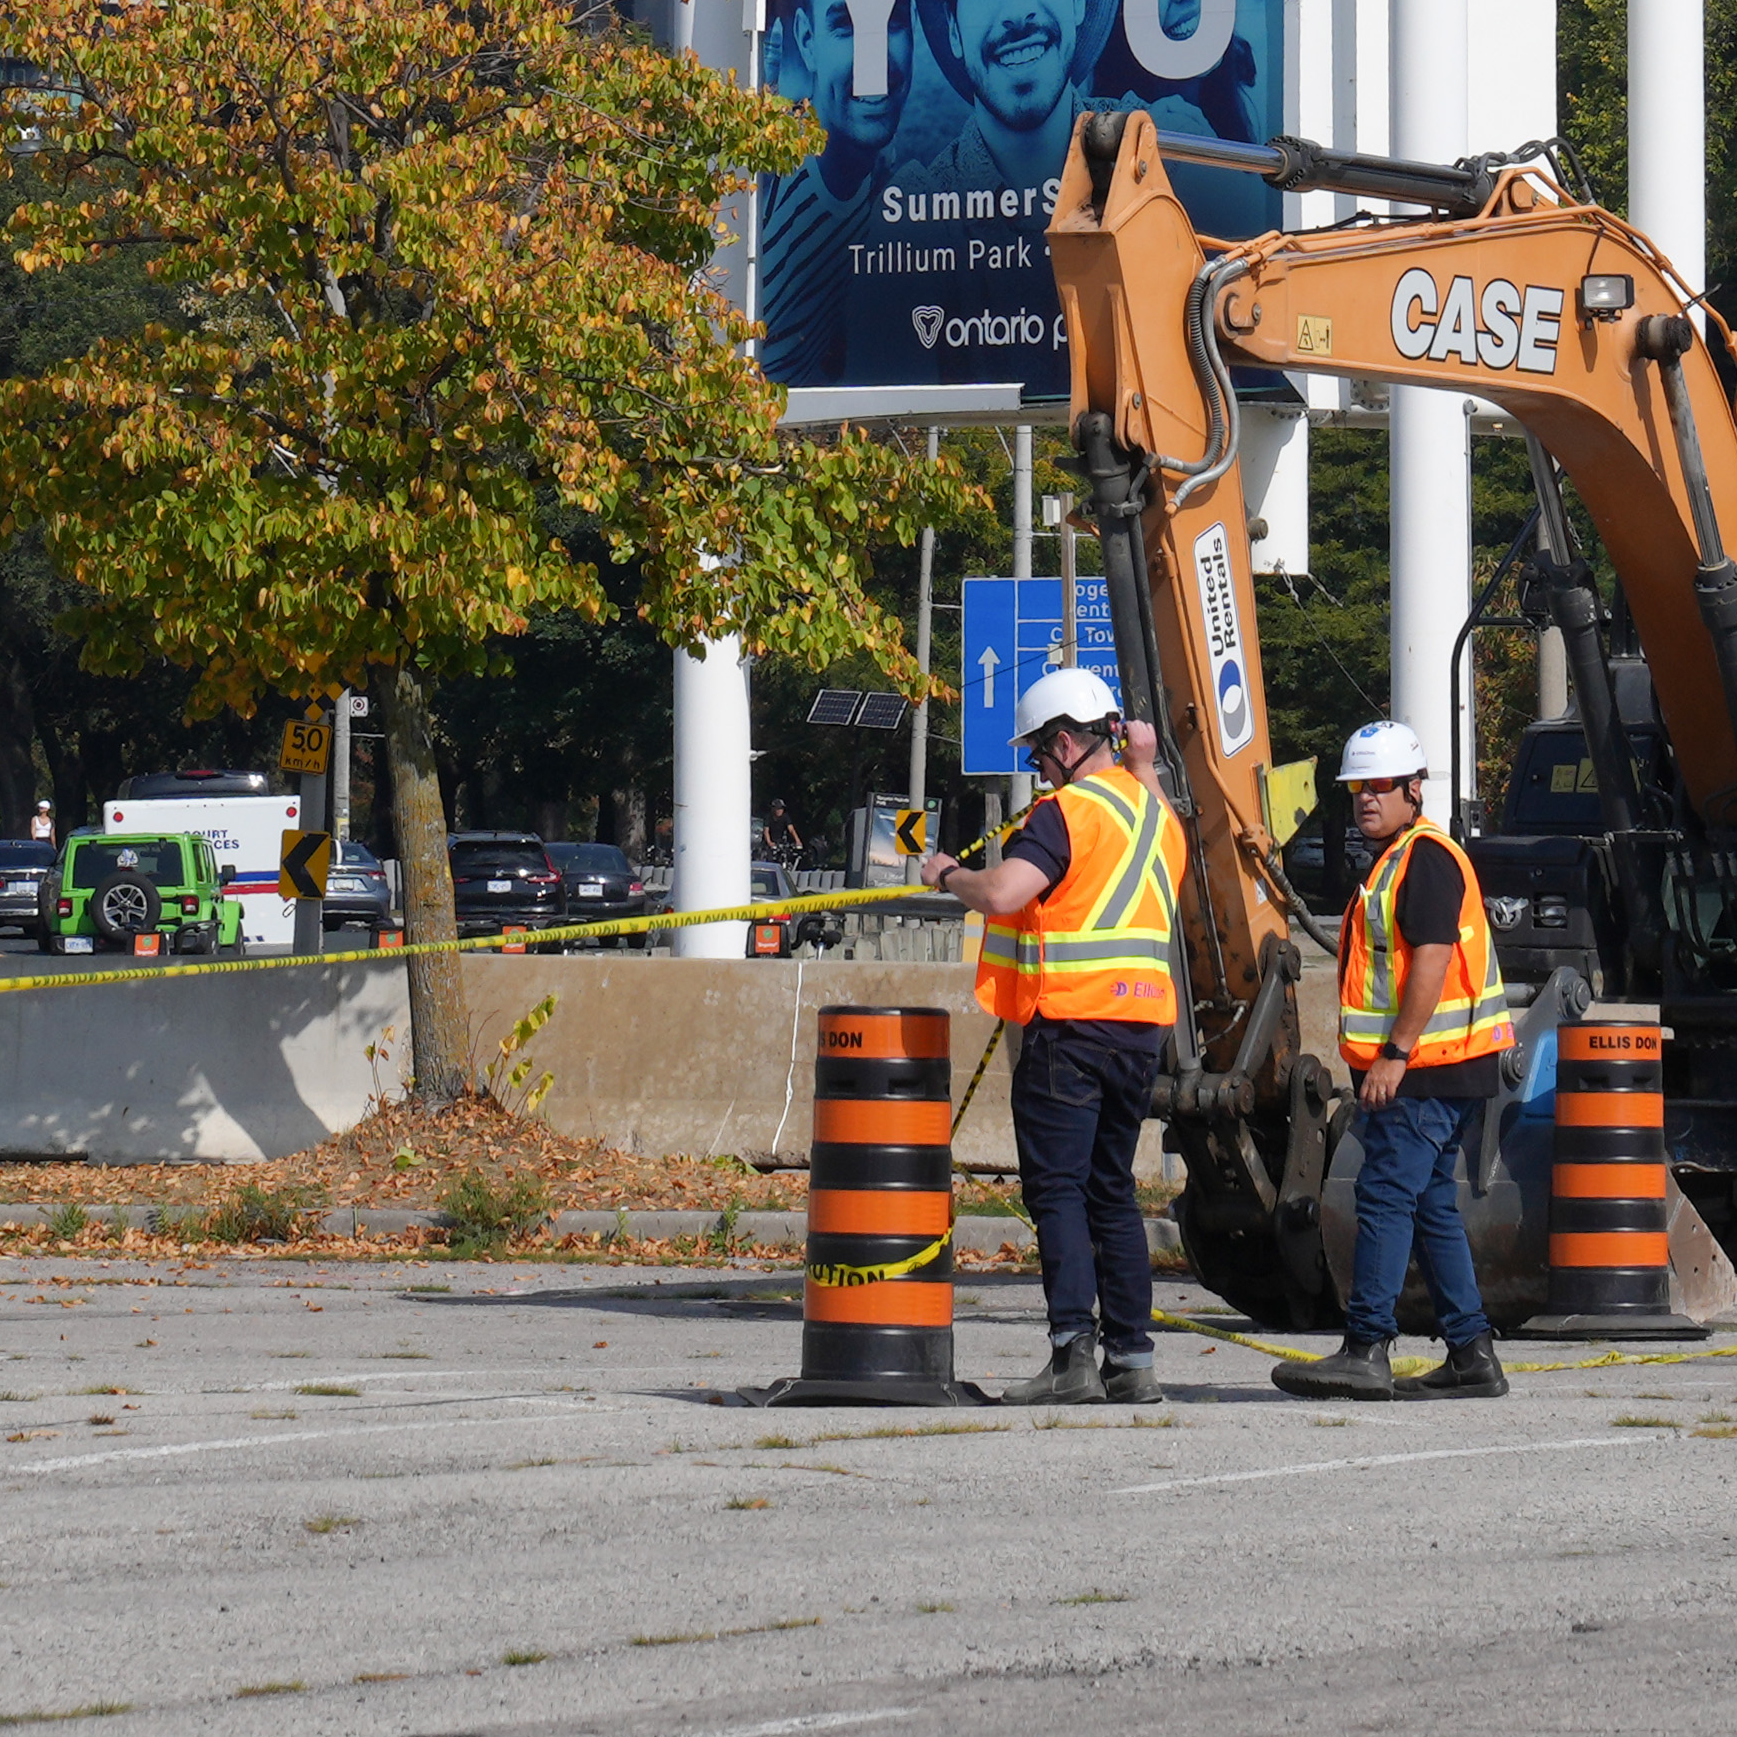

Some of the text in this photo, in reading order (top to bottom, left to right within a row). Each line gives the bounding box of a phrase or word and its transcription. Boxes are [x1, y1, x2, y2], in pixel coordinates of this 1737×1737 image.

[882, 177, 1059, 224] SummerS
[849, 236, 1032, 276] Trillium Park
[945, 313, 1044, 348] ontario
[1391, 267, 1565, 375] CASE
[1200, 556, 1224, 657] United
[1213, 538, 1236, 648] Rentals
[291, 726, 323, 752] 50
[285, 755, 321, 769] km/h
[829, 1031, 862, 1048] DON
[1589, 1035, 1657, 1050] ELLIS DON
[810, 1263, 885, 1287] UTION
